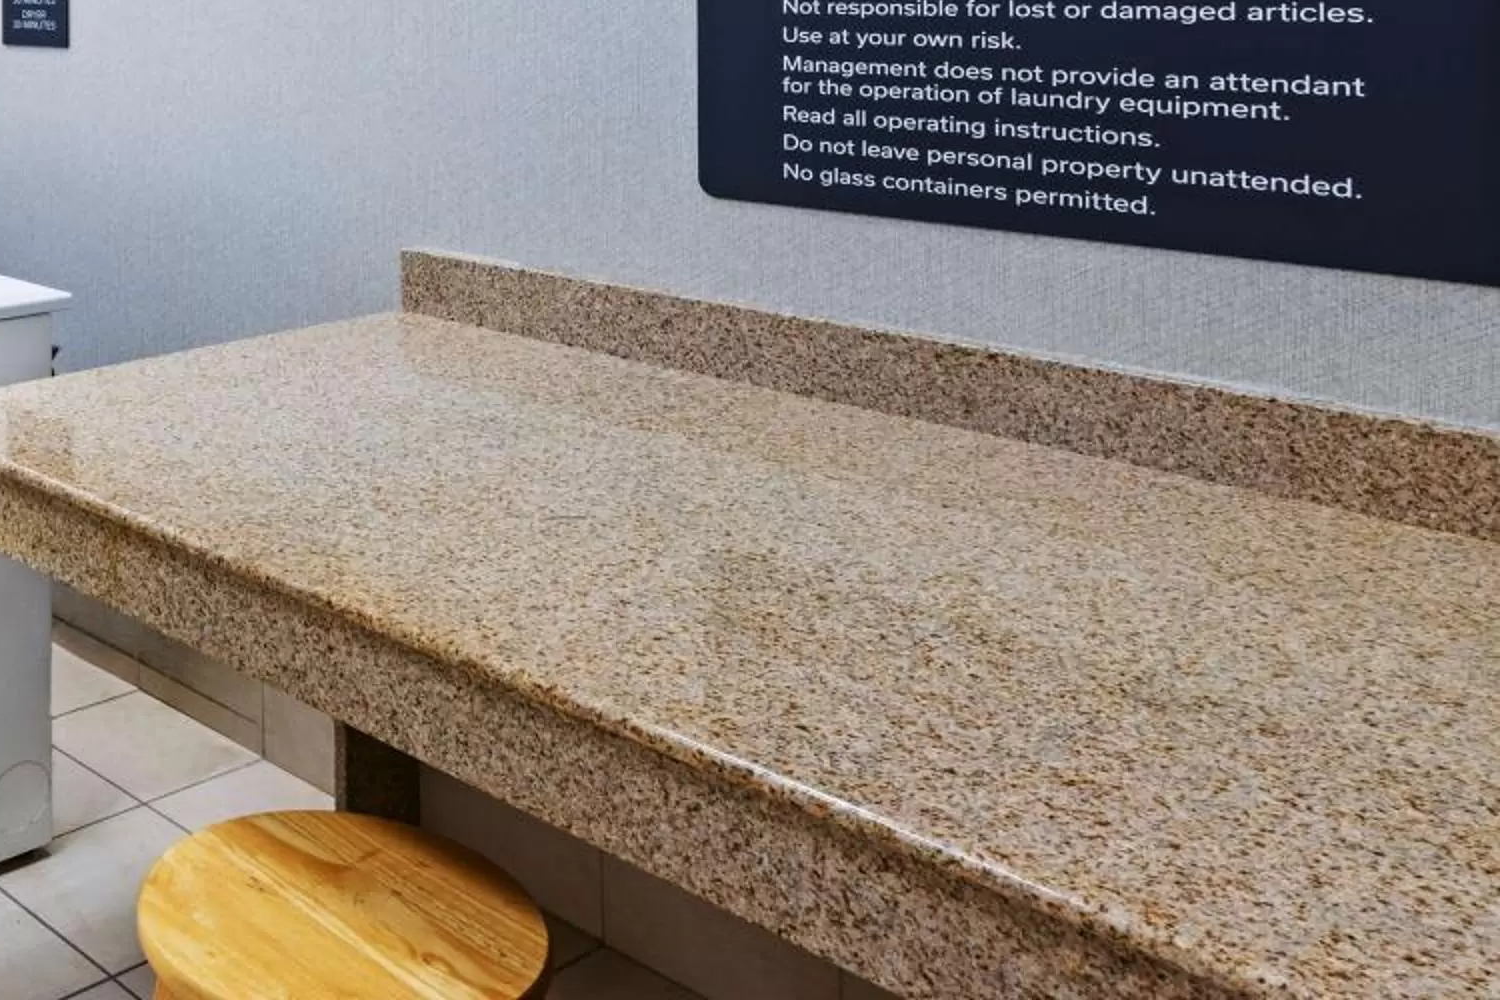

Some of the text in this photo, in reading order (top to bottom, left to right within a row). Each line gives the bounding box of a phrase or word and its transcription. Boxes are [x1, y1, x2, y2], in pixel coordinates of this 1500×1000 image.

[965, 0, 1001, 17] for
[1008, 0, 1056, 19] lost
[1063, 4, 1093, 19] or
[1099, 0, 1236, 25] damaged
[1247, 1, 1373, 23] articles.
[782, 26, 1021, 49] Use at your own risk.
[783, 55, 1365, 97] Management does not provide an attendant
[782, 76, 1290, 121] for the operation of laundry equipment.
[783, 105, 1161, 148] Read all operating instructions.
[783, 133, 1362, 199] Do not leave personal property unattended.
[782, 163, 1156, 215] No glass containers permitted.
